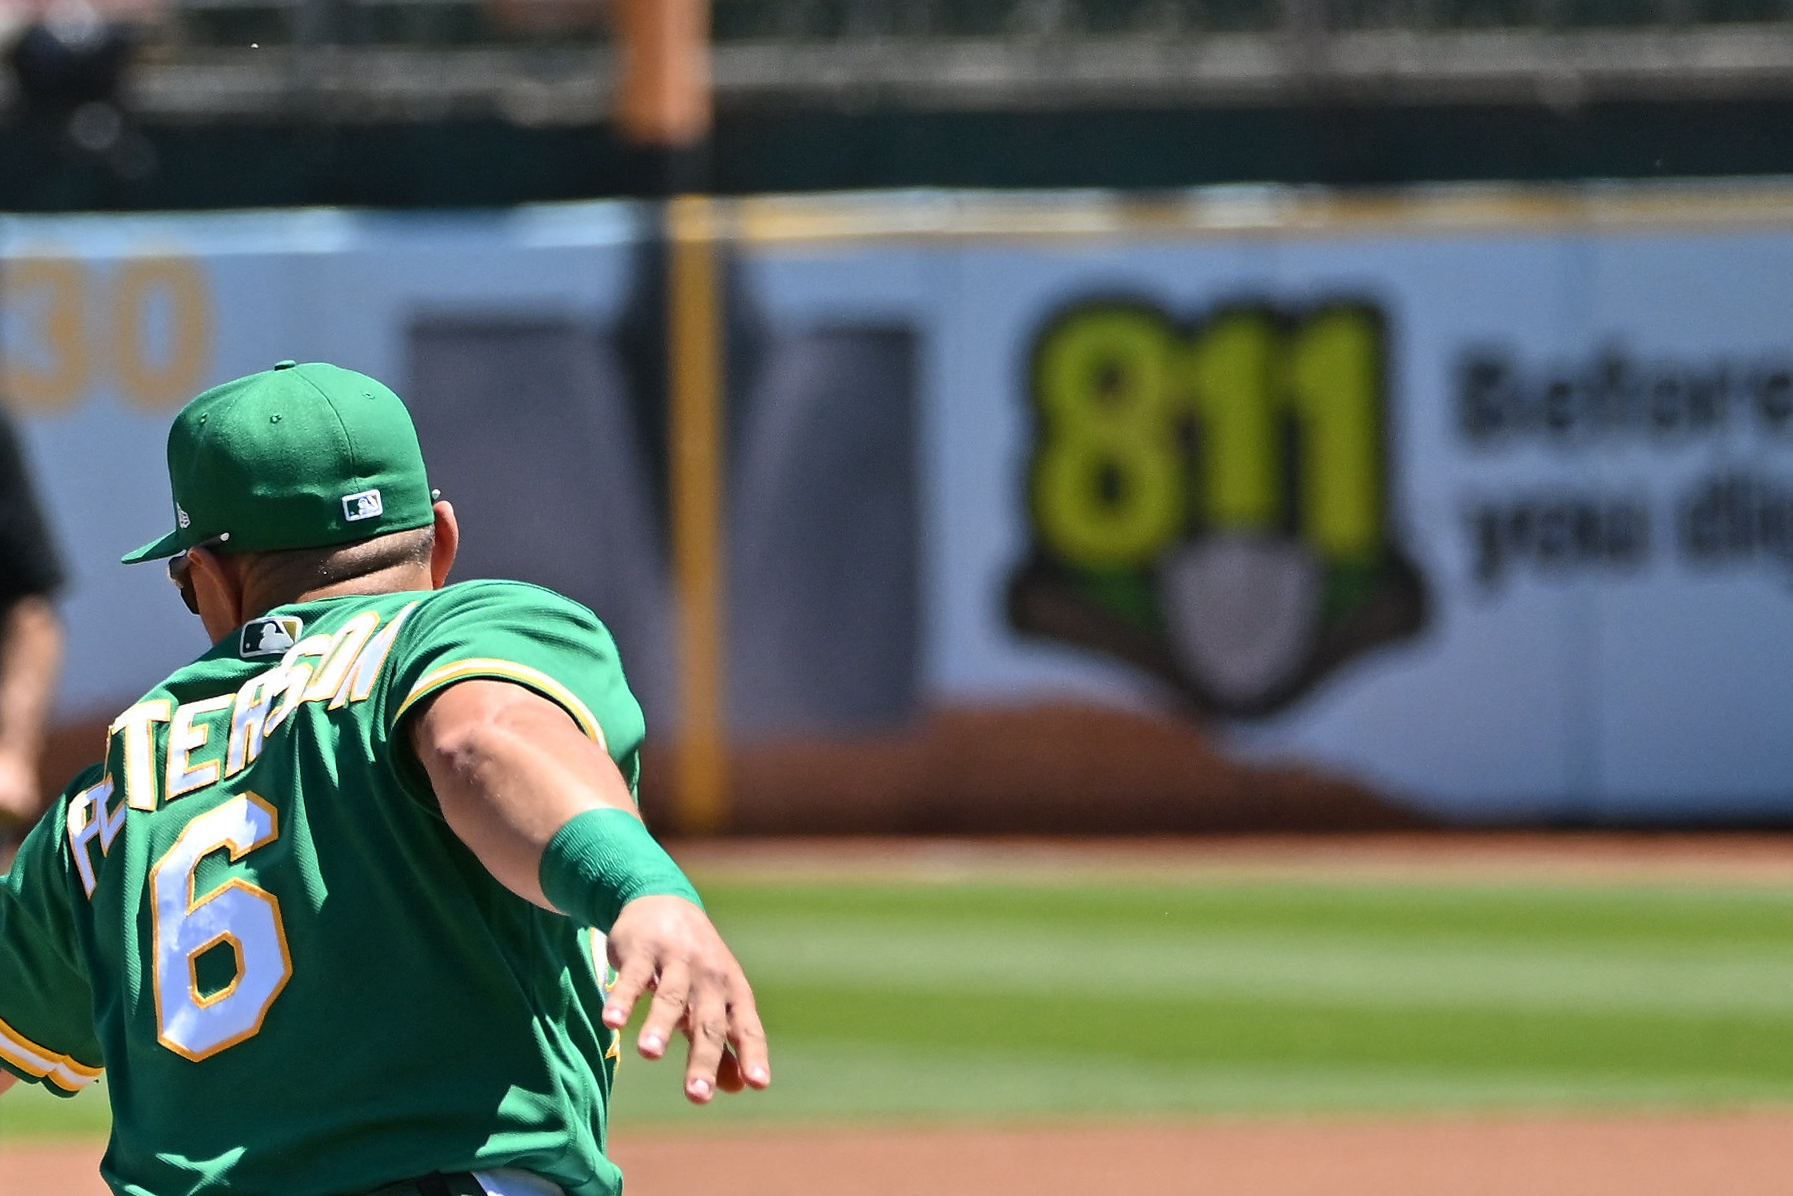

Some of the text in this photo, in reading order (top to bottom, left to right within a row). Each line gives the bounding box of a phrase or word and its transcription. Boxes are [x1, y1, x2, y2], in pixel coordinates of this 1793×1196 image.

[1031, 298, 1387, 574] 811
[1463, 494, 1647, 592] you
[150, 791, 294, 1063] 6
